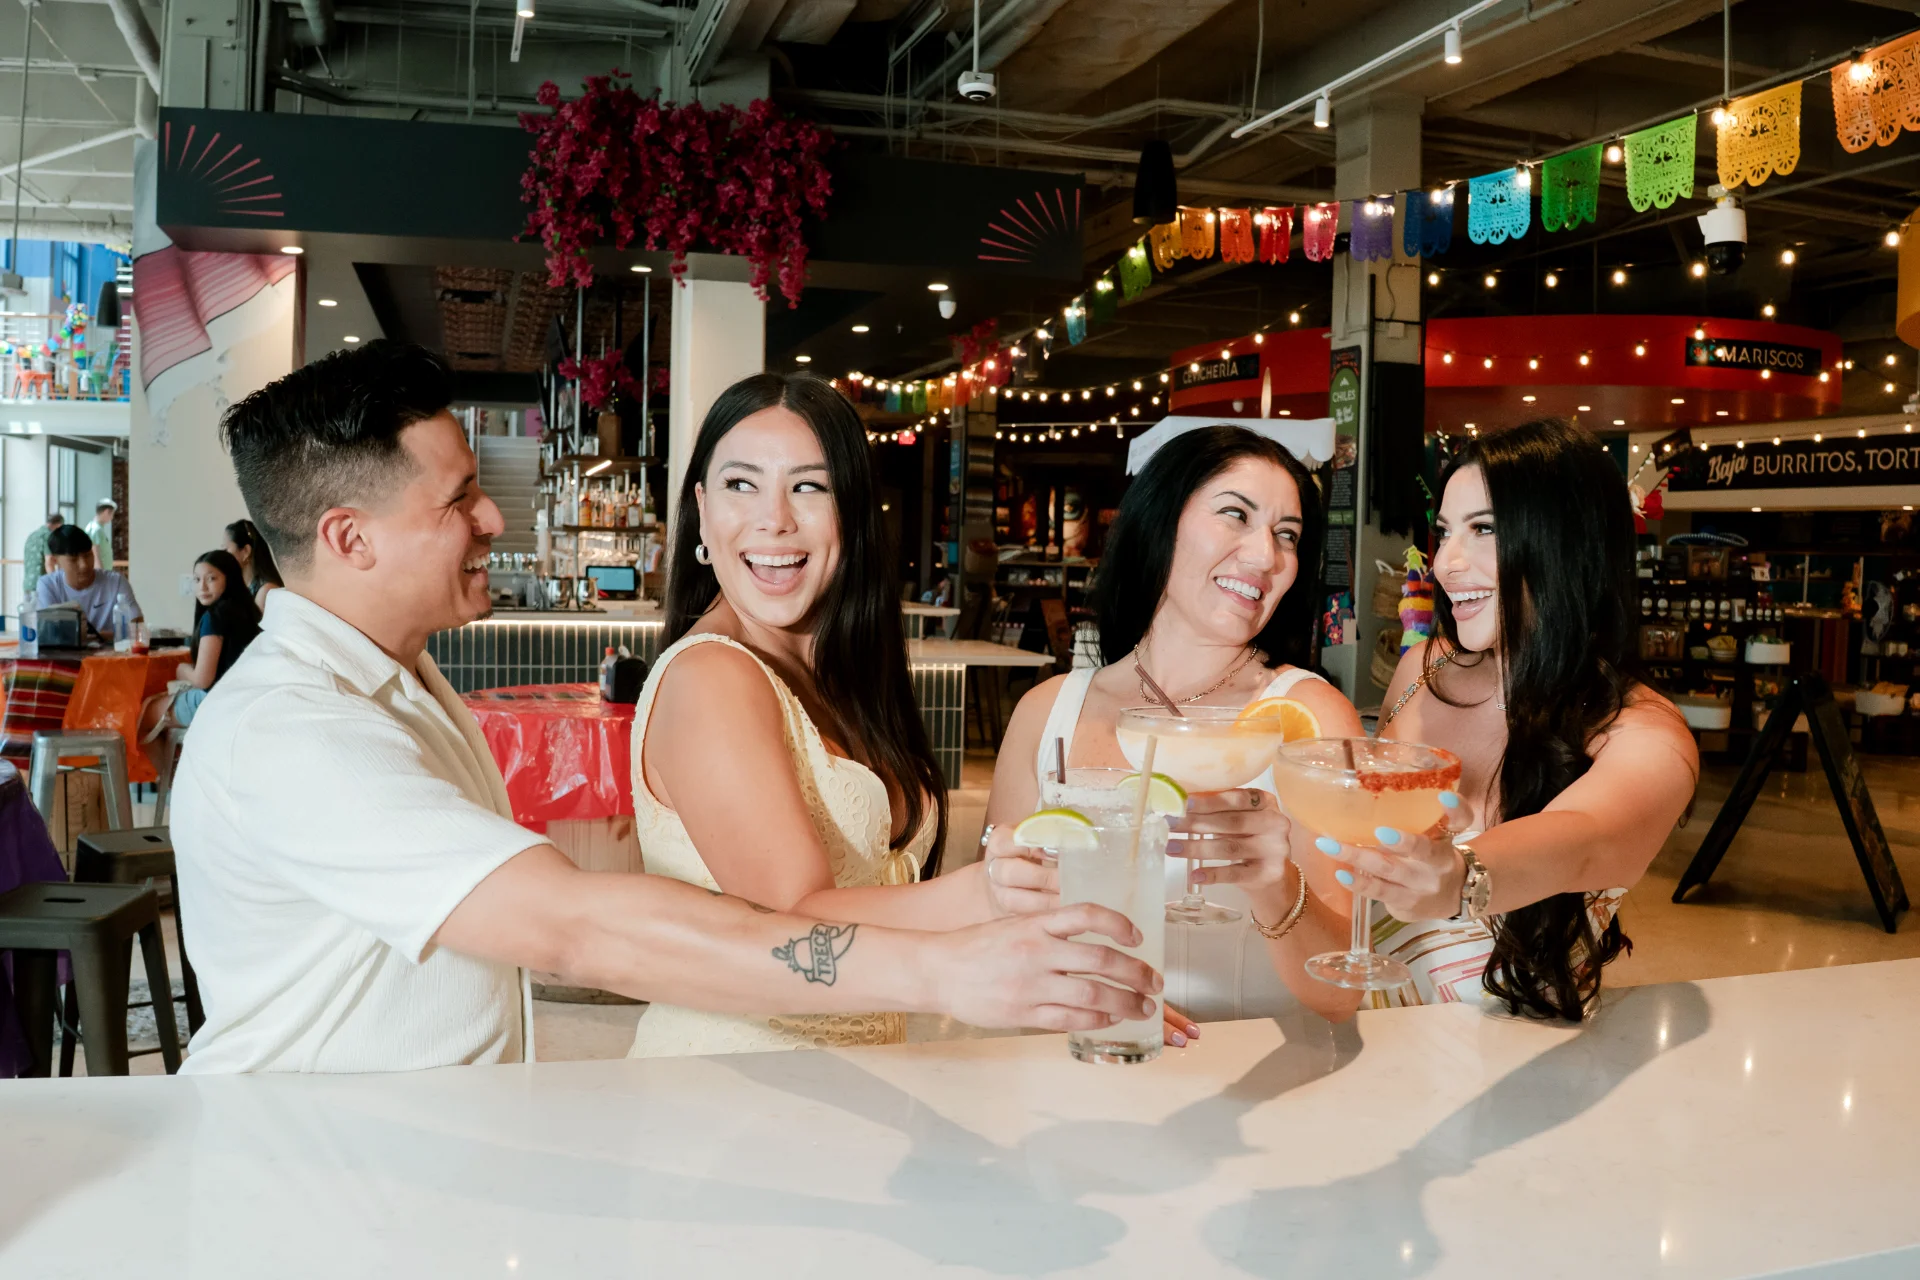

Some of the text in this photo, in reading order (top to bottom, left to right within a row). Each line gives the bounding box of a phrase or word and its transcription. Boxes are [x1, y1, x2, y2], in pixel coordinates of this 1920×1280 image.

[1722, 345, 1804, 369] MARISCOS
[1332, 390, 1356, 403] CHILES
[1706, 452, 1749, 486] Baja
[1754, 450, 1862, 474] BURRITOS,
[814, 927, 831, 976] TRECE
